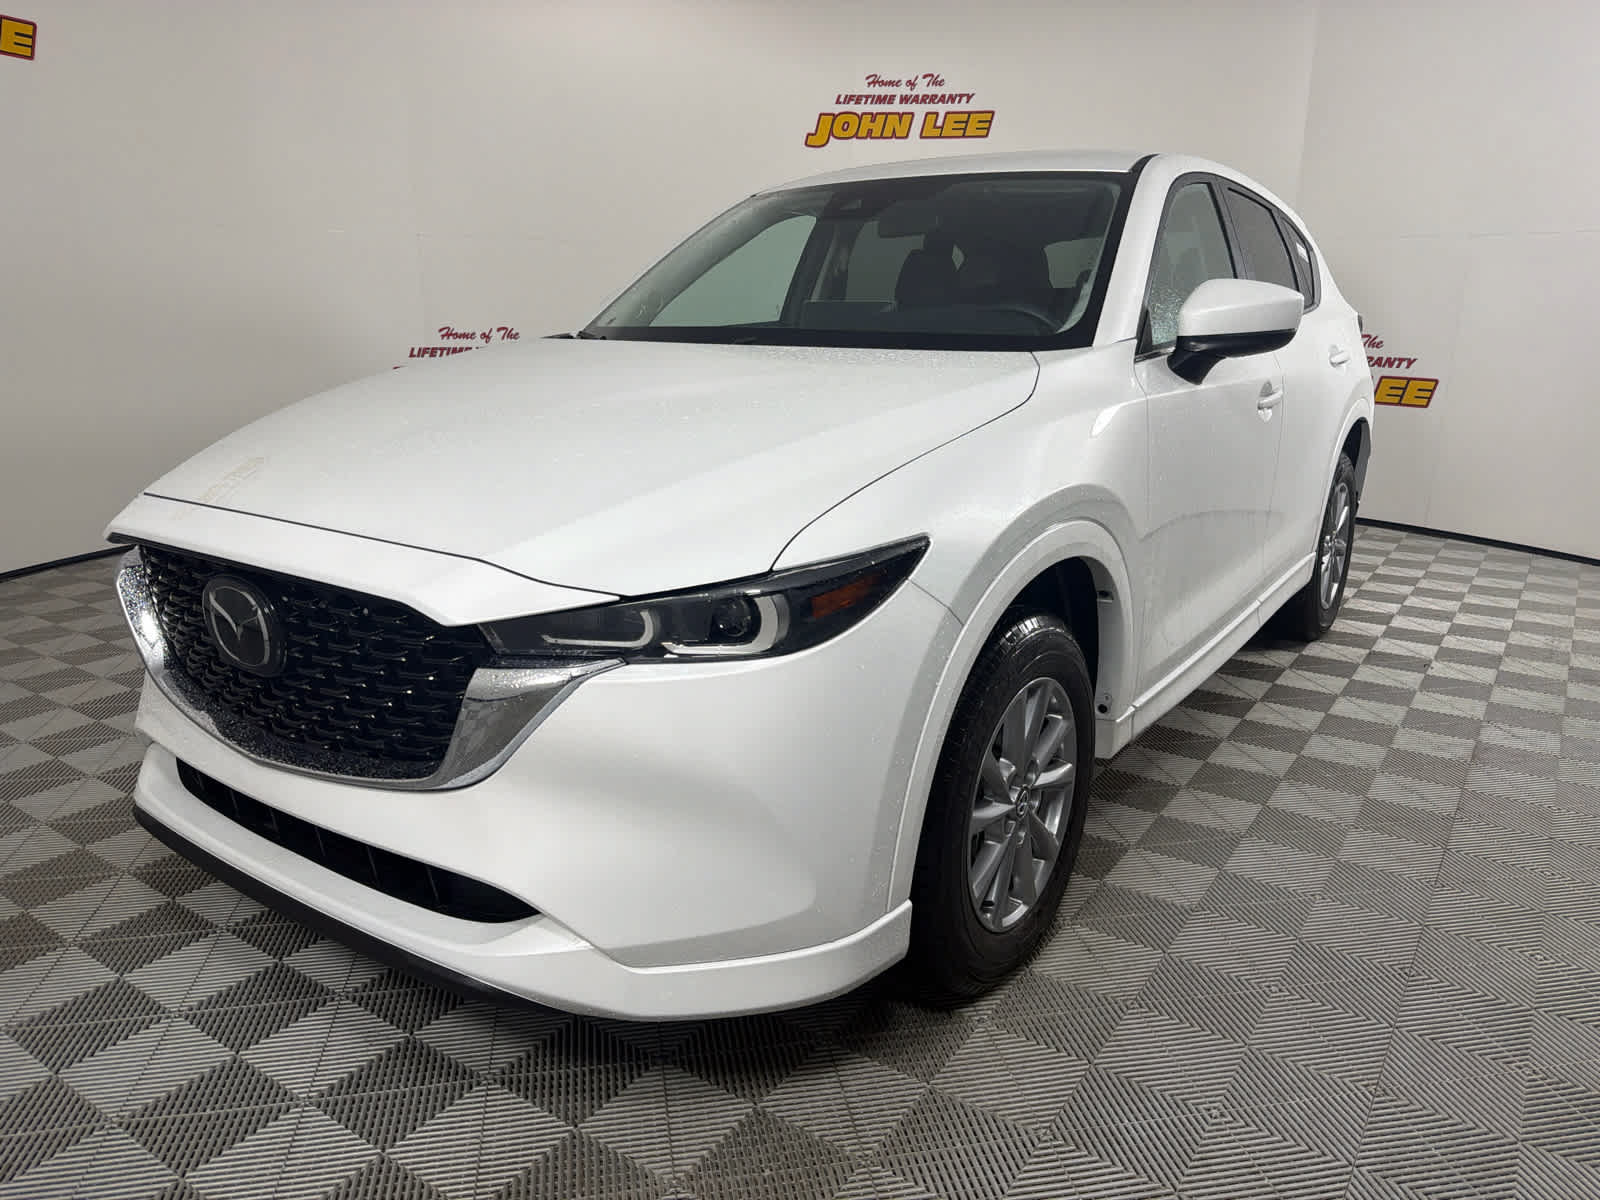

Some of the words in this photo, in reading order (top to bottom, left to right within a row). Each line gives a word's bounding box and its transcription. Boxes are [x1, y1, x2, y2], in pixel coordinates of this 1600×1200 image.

[865, 74, 902, 88] Home
[905, 76, 919, 91] of
[922, 73, 945, 87] The
[835, 94, 896, 105] LIFETIME
[899, 93, 975, 105] WARRANTY
[804, 111, 915, 148] JOHN
[919, 110, 995, 139] LEE
[438, 326, 477, 340] Home
[480, 328, 493, 344] of
[496, 326, 520, 341] The
[1361, 334, 1384, 349] The
[1366, 356, 1418, 369] RANTY
[1374, 375, 1439, 408] EE
